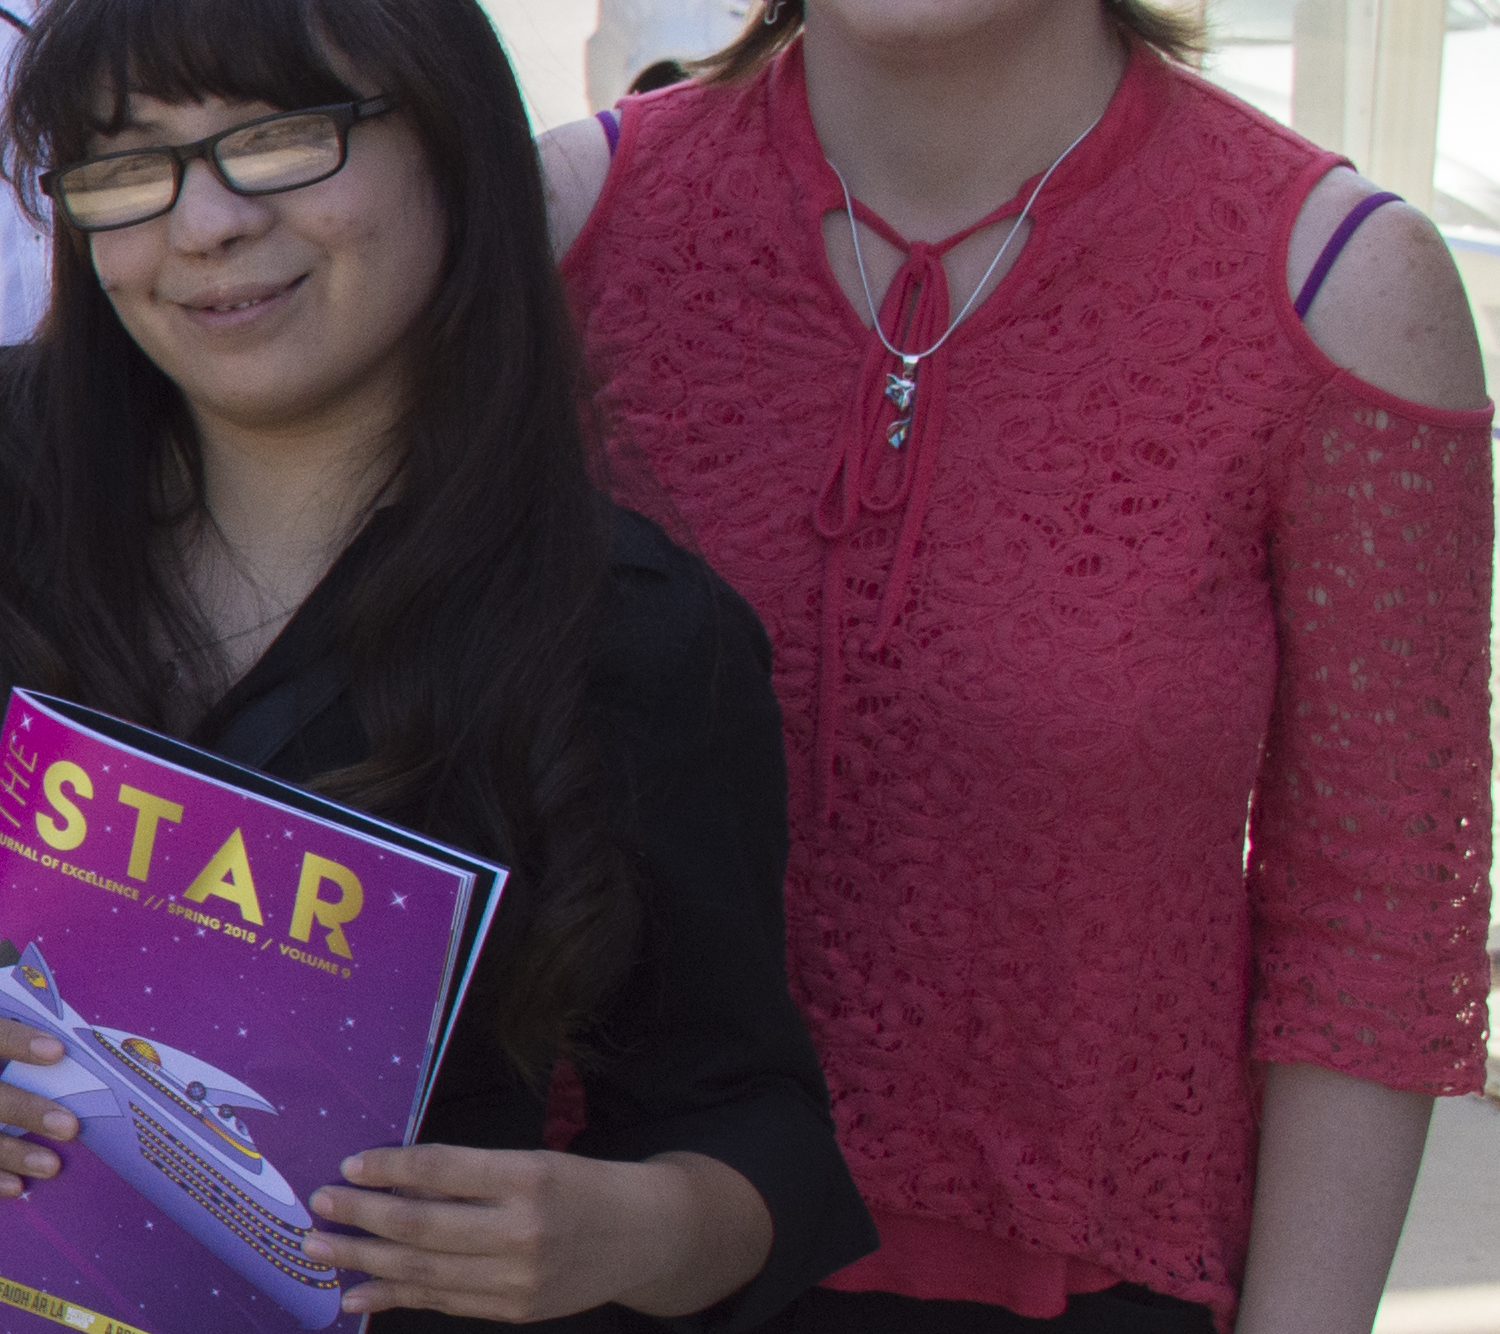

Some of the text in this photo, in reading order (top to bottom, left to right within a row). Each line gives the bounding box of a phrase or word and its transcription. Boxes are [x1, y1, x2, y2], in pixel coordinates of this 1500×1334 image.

[36, 760, 364, 960] STAR
[41, 854, 60, 868] OF
[61, 862, 140, 900] EXCELLENCE
[168, 903, 221, 930] SPRING
[224, 923, 257, 944] 2018
[279, 943, 339, 975] VOLUME
[341, 968, 351, 979] 9
